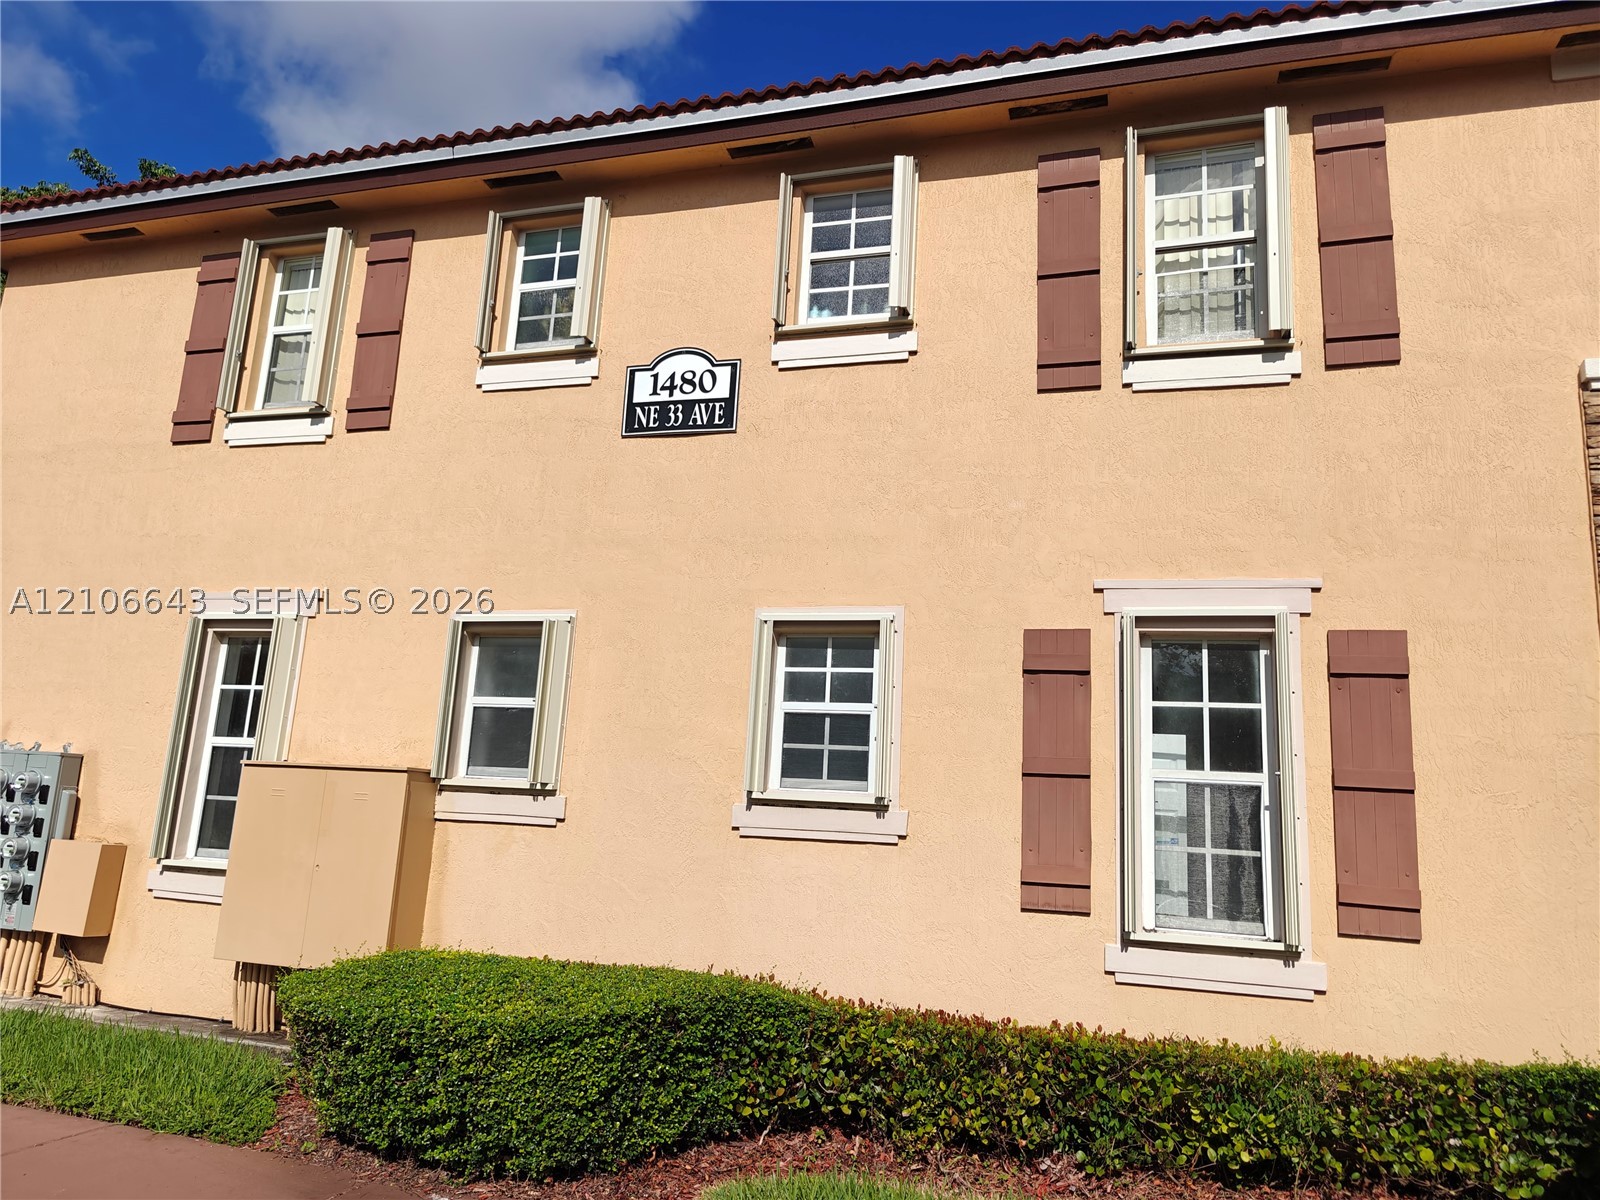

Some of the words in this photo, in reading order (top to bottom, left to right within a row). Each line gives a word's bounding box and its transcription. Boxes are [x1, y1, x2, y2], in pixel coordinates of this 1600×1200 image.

[649, 369, 717, 398] 1480
[634, 405, 660, 428] NE
[665, 404, 683, 427] 33
[688, 402, 725, 425] AVE
